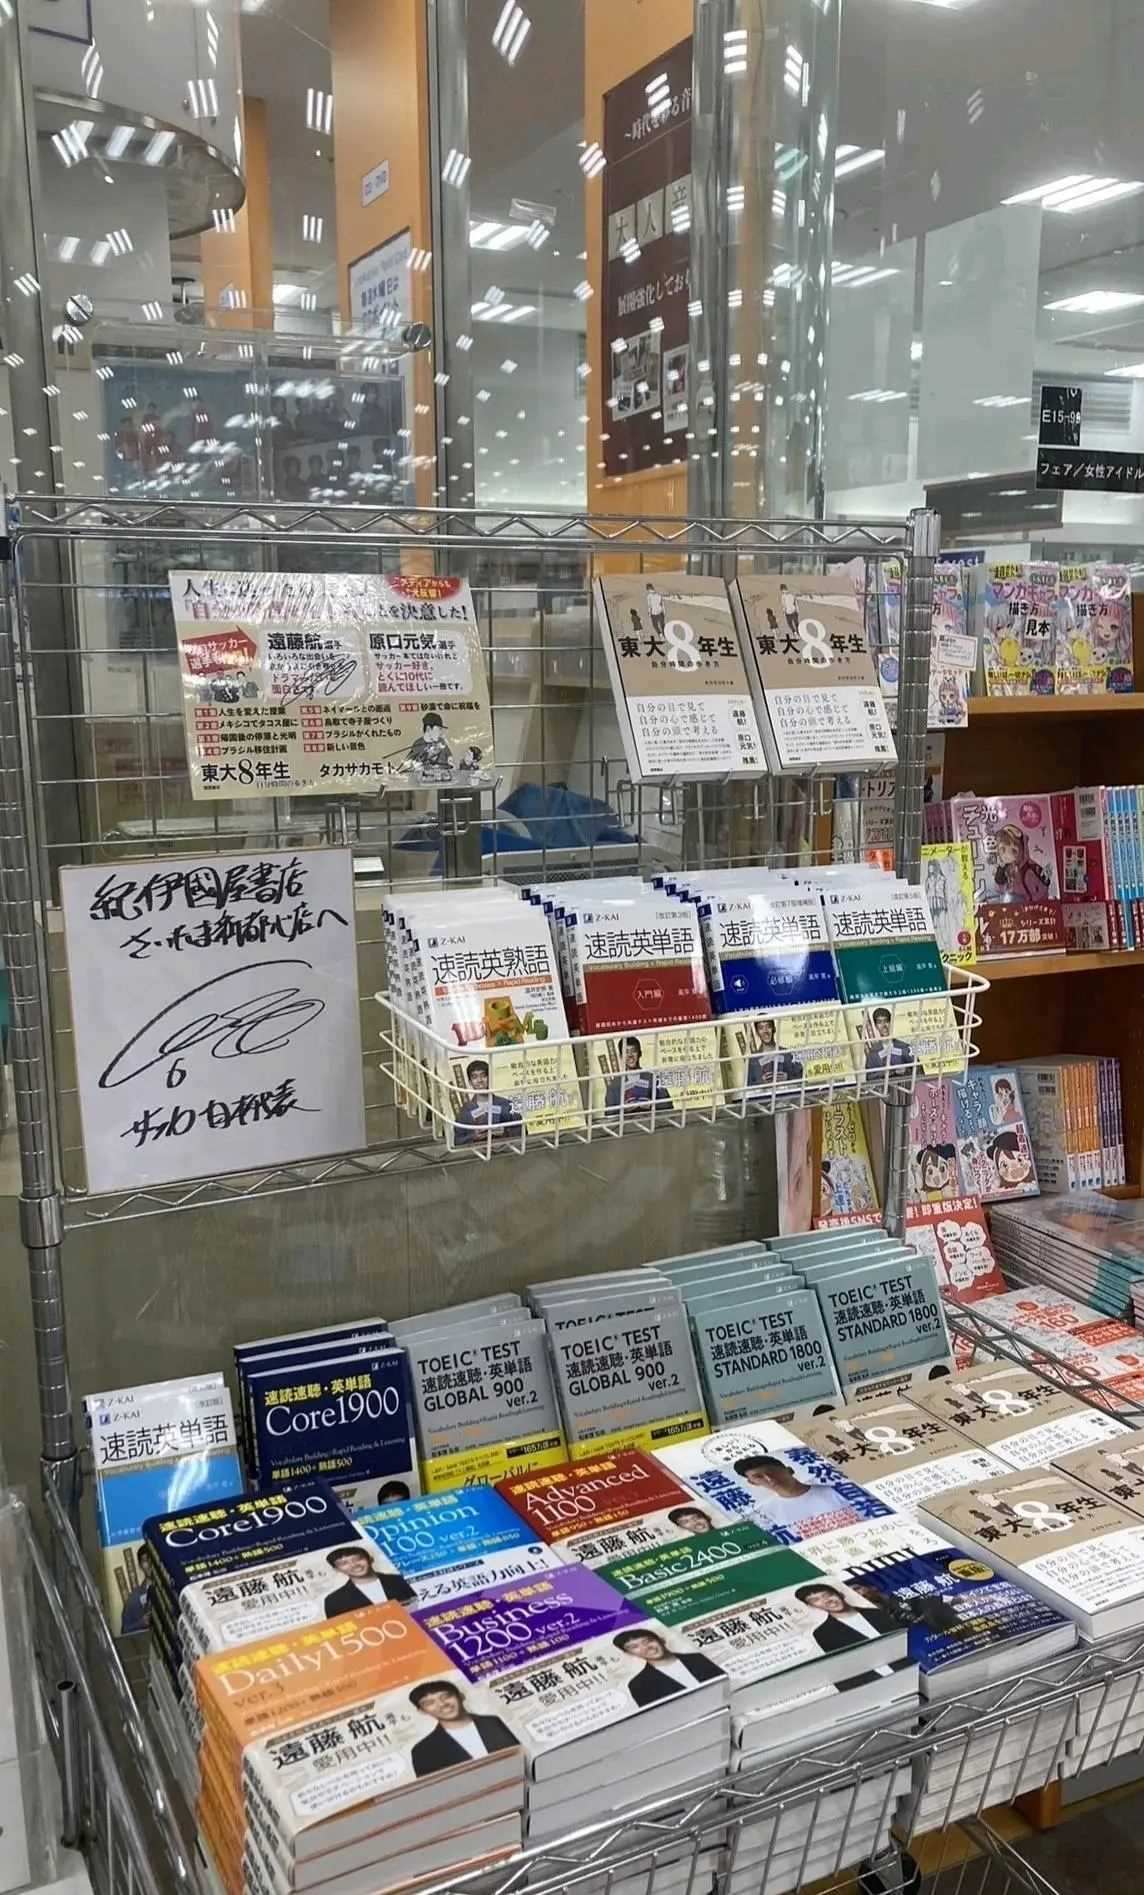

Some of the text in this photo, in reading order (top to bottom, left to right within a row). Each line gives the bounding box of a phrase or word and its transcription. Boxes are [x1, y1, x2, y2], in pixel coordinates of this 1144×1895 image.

[369, 633, 437, 650] 原口元気
[617, 620, 738, 672] 東大8年生
[756, 619, 867, 668] 東大8年生
[1026, 619, 1050, 637] 見本
[201, 759, 291, 784] 東大8年生
[90, 857, 308, 920] 紀伊國屋書店
[720, 915, 821, 947] 速読英単語
[833, 908, 926, 937] 速読英単語
[585, 928, 694, 960] 速読英単語
[942, 951, 972, 962] クニック
[431, 944, 550, 985] 速読英熟語
[166, 1058, 186, 1088] 6
[880, 1275, 912, 1296] TEST
[759, 1310, 793, 1331] TEST
[833, 1289, 925, 1326] 速読速聴・英単語
[837, 1303, 939, 1342] STANDARD 1800
[623, 1325, 661, 1347] TEST
[710, 1325, 808, 1361] 速読速聴・英単語
[916, 1318, 941, 1336] ver.2
[481, 1340, 521, 1362] TEST
[566, 1340, 673, 1379] 速読速聴・英単語
[715, 1340, 823, 1378] STANDARD 1800
[798, 1356, 826, 1373] ver.2
[265, 1374, 372, 1406] 速読速聴・英単語
[421, 1357, 533, 1394] 速読速聴・英単語
[569, 1361, 666, 1397] GLOBAL 900
[648, 1374, 680, 1392] ver.2
[266, 1386, 399, 1437] Core1900
[424, 1378, 524, 1412] GLOBAL 900
[506, 1391, 538, 1409] ver.2
[948, 1383, 1061, 1427] 東大8年生
[100, 1414, 229, 1464] 速読英単語
[827, 1420, 948, 1465] 東大8年生
[464, 1461, 539, 1487] グローバル
[525, 1464, 650, 1512] Advanced
[165, 1496, 328, 1548] Core1900
[532, 1495, 596, 1525] 1100
[975, 1495, 1106, 1543] 東大8年生
[571, 1527, 656, 1562] 遠藤航
[616, 1542, 742, 1590] Basic2400
[205, 1569, 305, 1608] 遠藤航
[432, 1591, 575, 1646] Business
[688, 1606, 784, 1648] 遠藤航
[449, 1612, 582, 1663] 1200 ver.2
[217, 1620, 408, 1697] Daily1500
[495, 1654, 599, 1705] 遠藤航
[269, 1712, 386, 1769] 遠藤航
